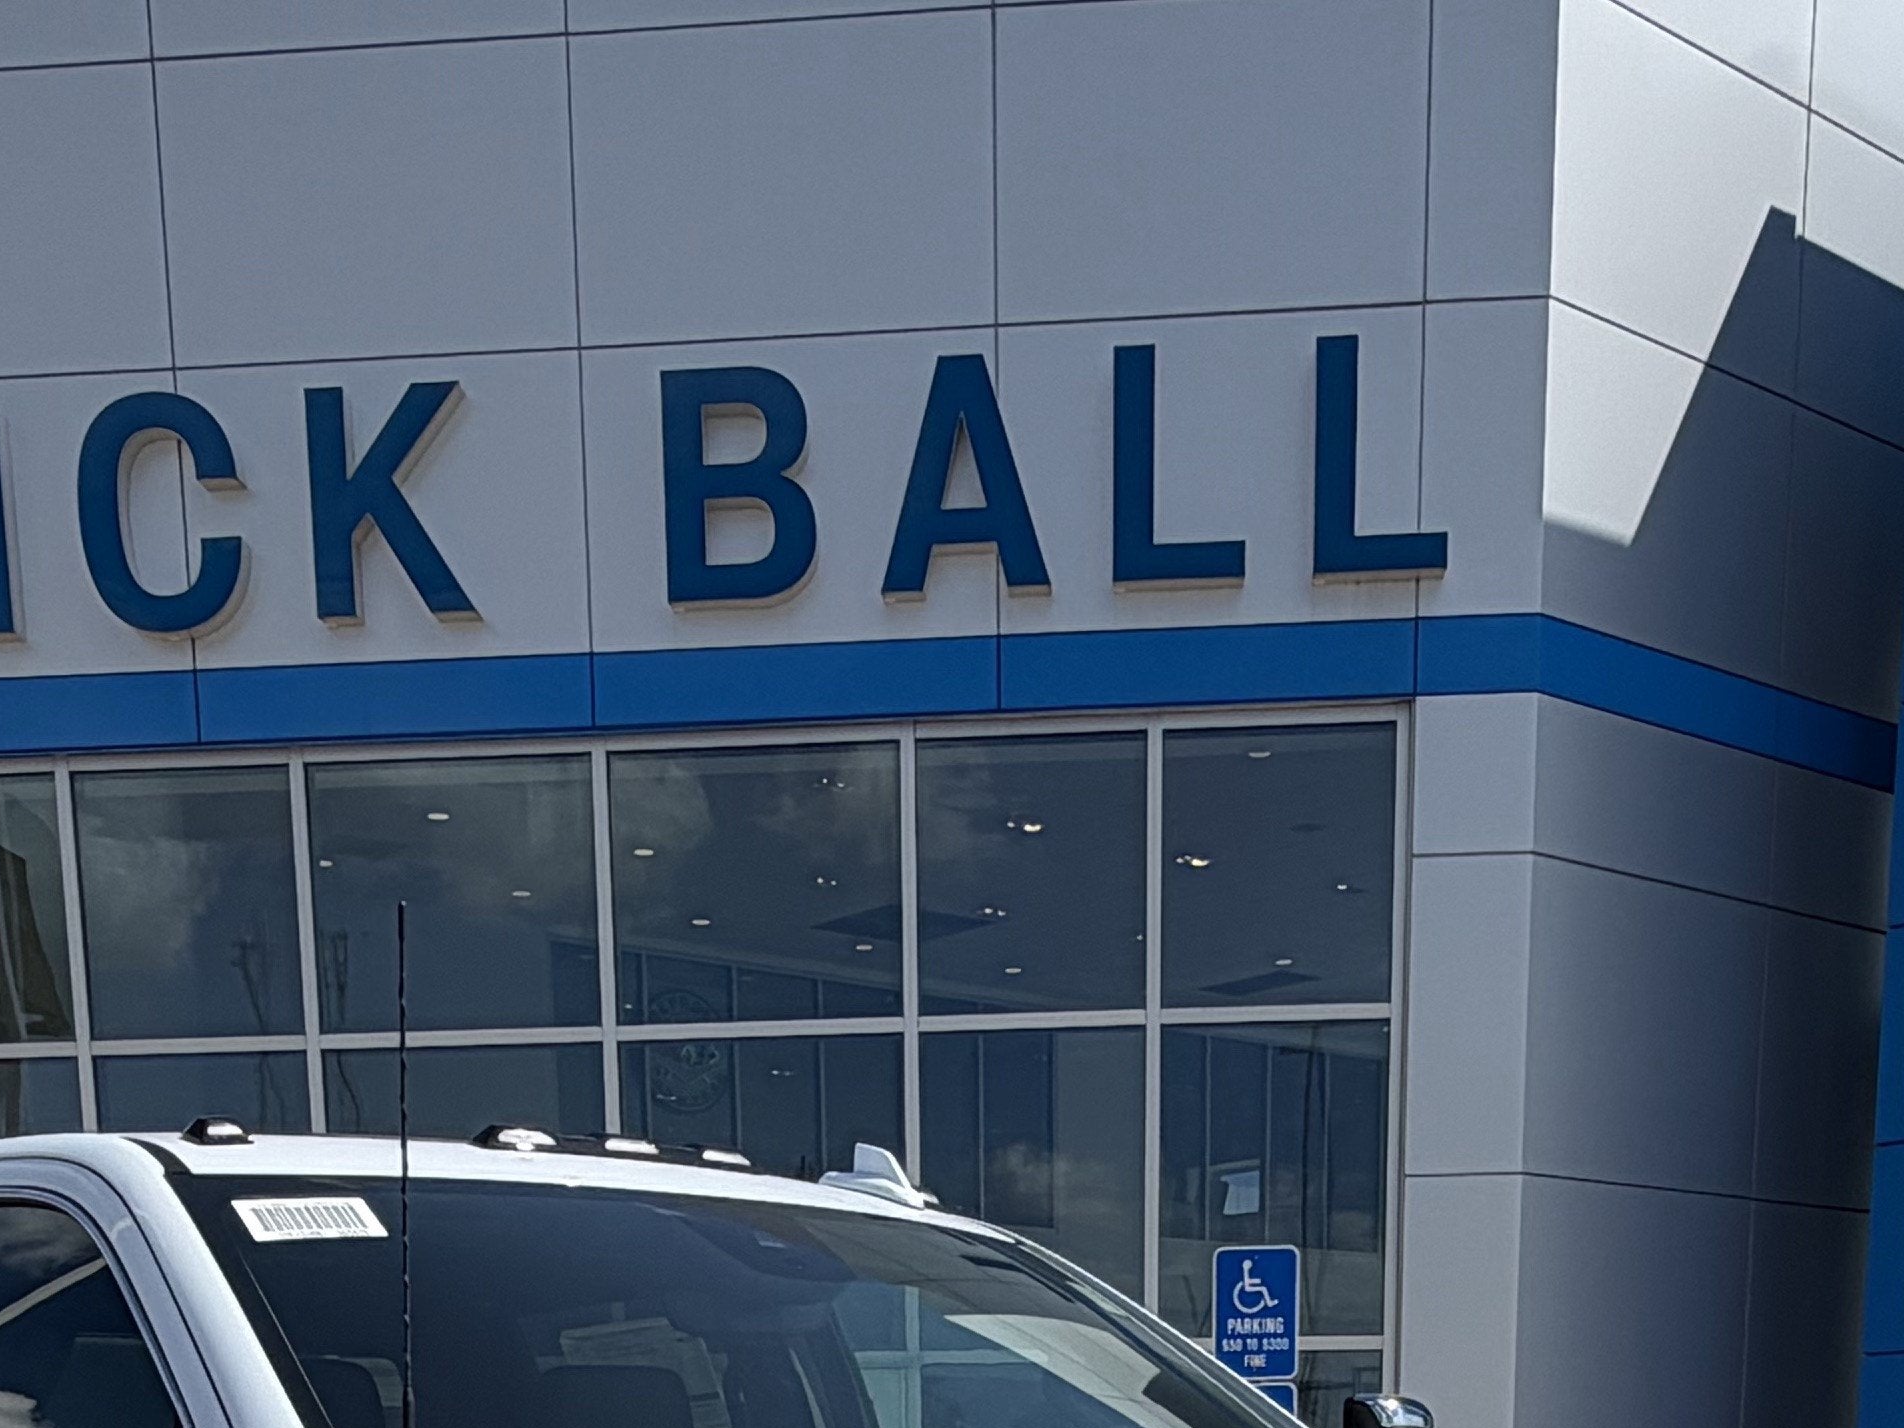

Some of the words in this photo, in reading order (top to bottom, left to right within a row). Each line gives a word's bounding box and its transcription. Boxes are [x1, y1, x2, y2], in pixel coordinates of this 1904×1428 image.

[660, 335, 1448, 611] BALL
[1226, 1317, 1284, 1335] PARKING
[1246, 1338, 1258, 1351] TO
